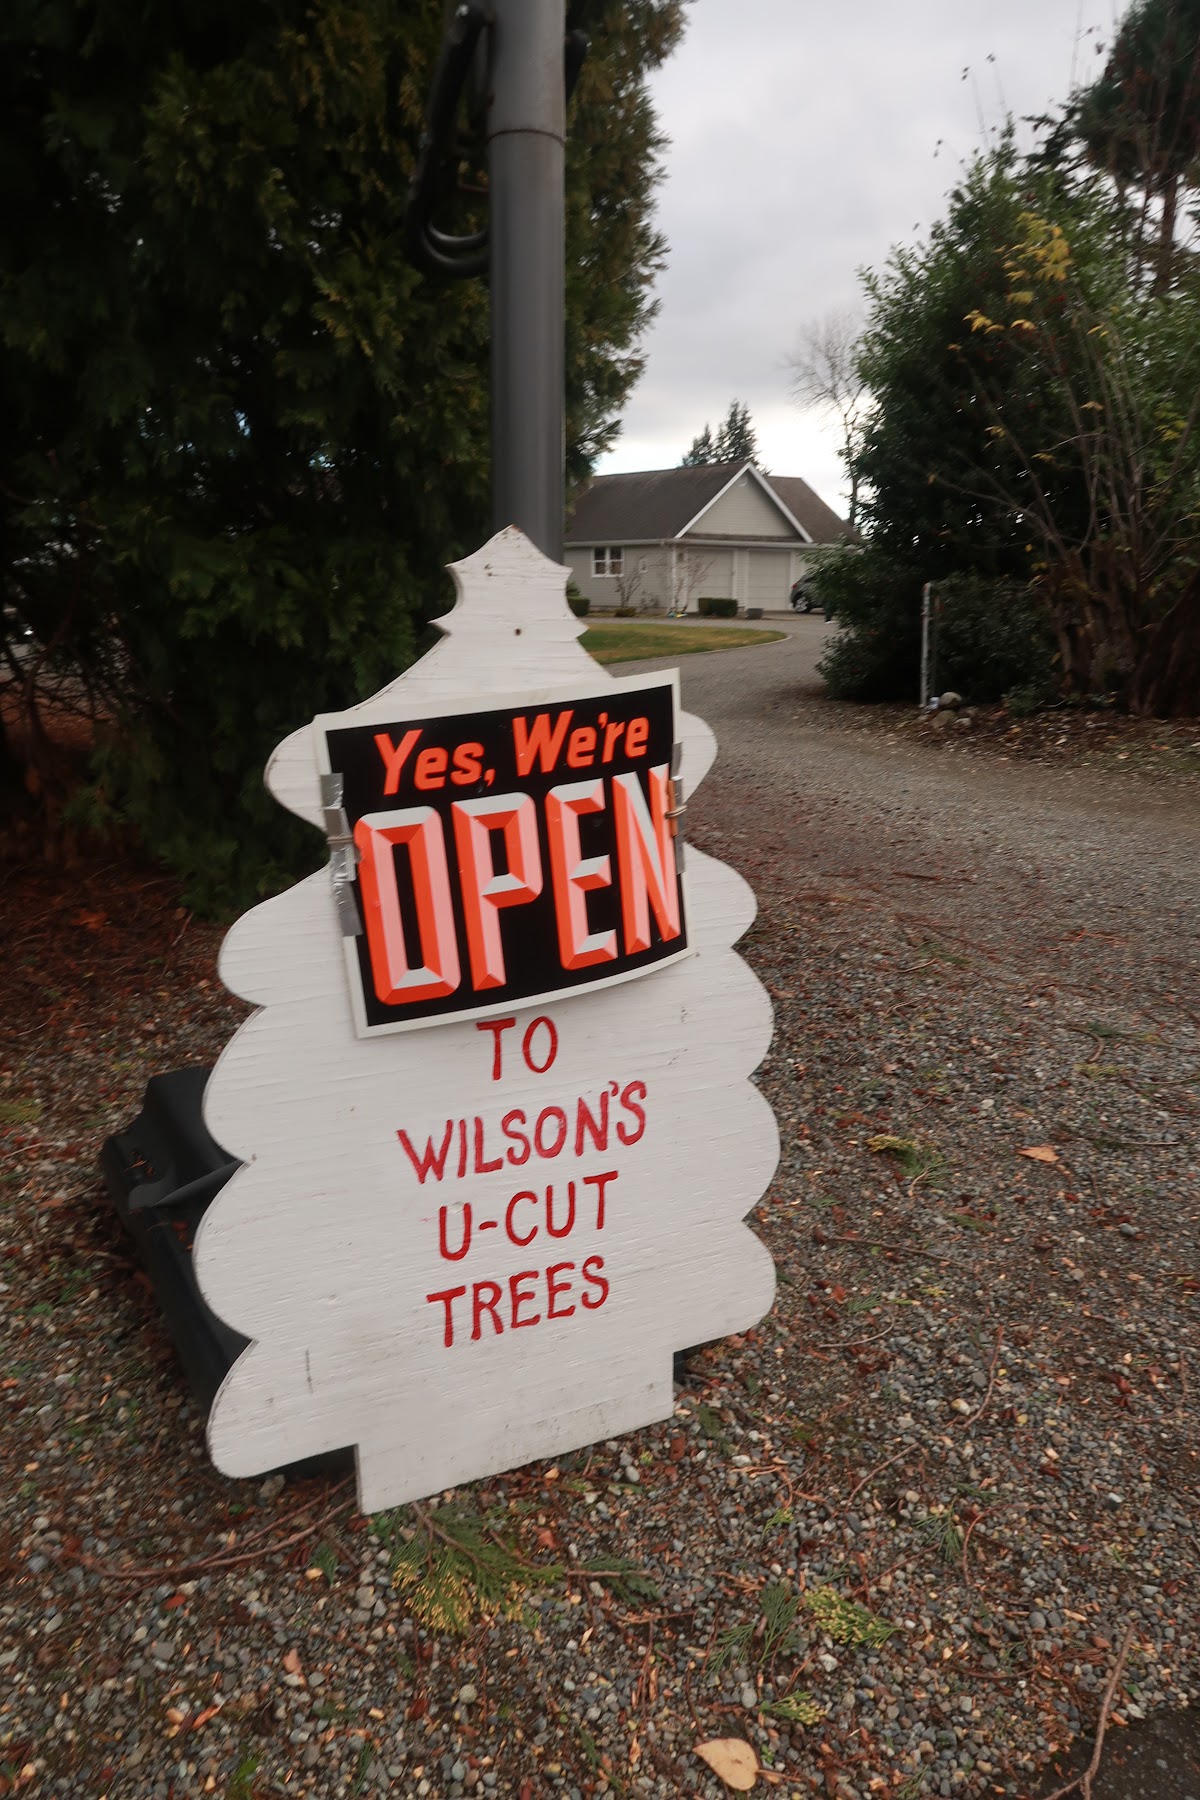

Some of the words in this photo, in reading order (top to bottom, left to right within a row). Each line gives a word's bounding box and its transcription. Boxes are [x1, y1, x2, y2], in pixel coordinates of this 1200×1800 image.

[373, 728, 497, 796] Yes,
[512, 709, 650, 778] We're
[353, 763, 681, 1006] OPEN
[476, 1016, 559, 1081] TO
[396, 1080, 648, 1184] WILSON'S
[439, 1170, 619, 1261] U-CUT
[426, 1256, 610, 1348] TREES
